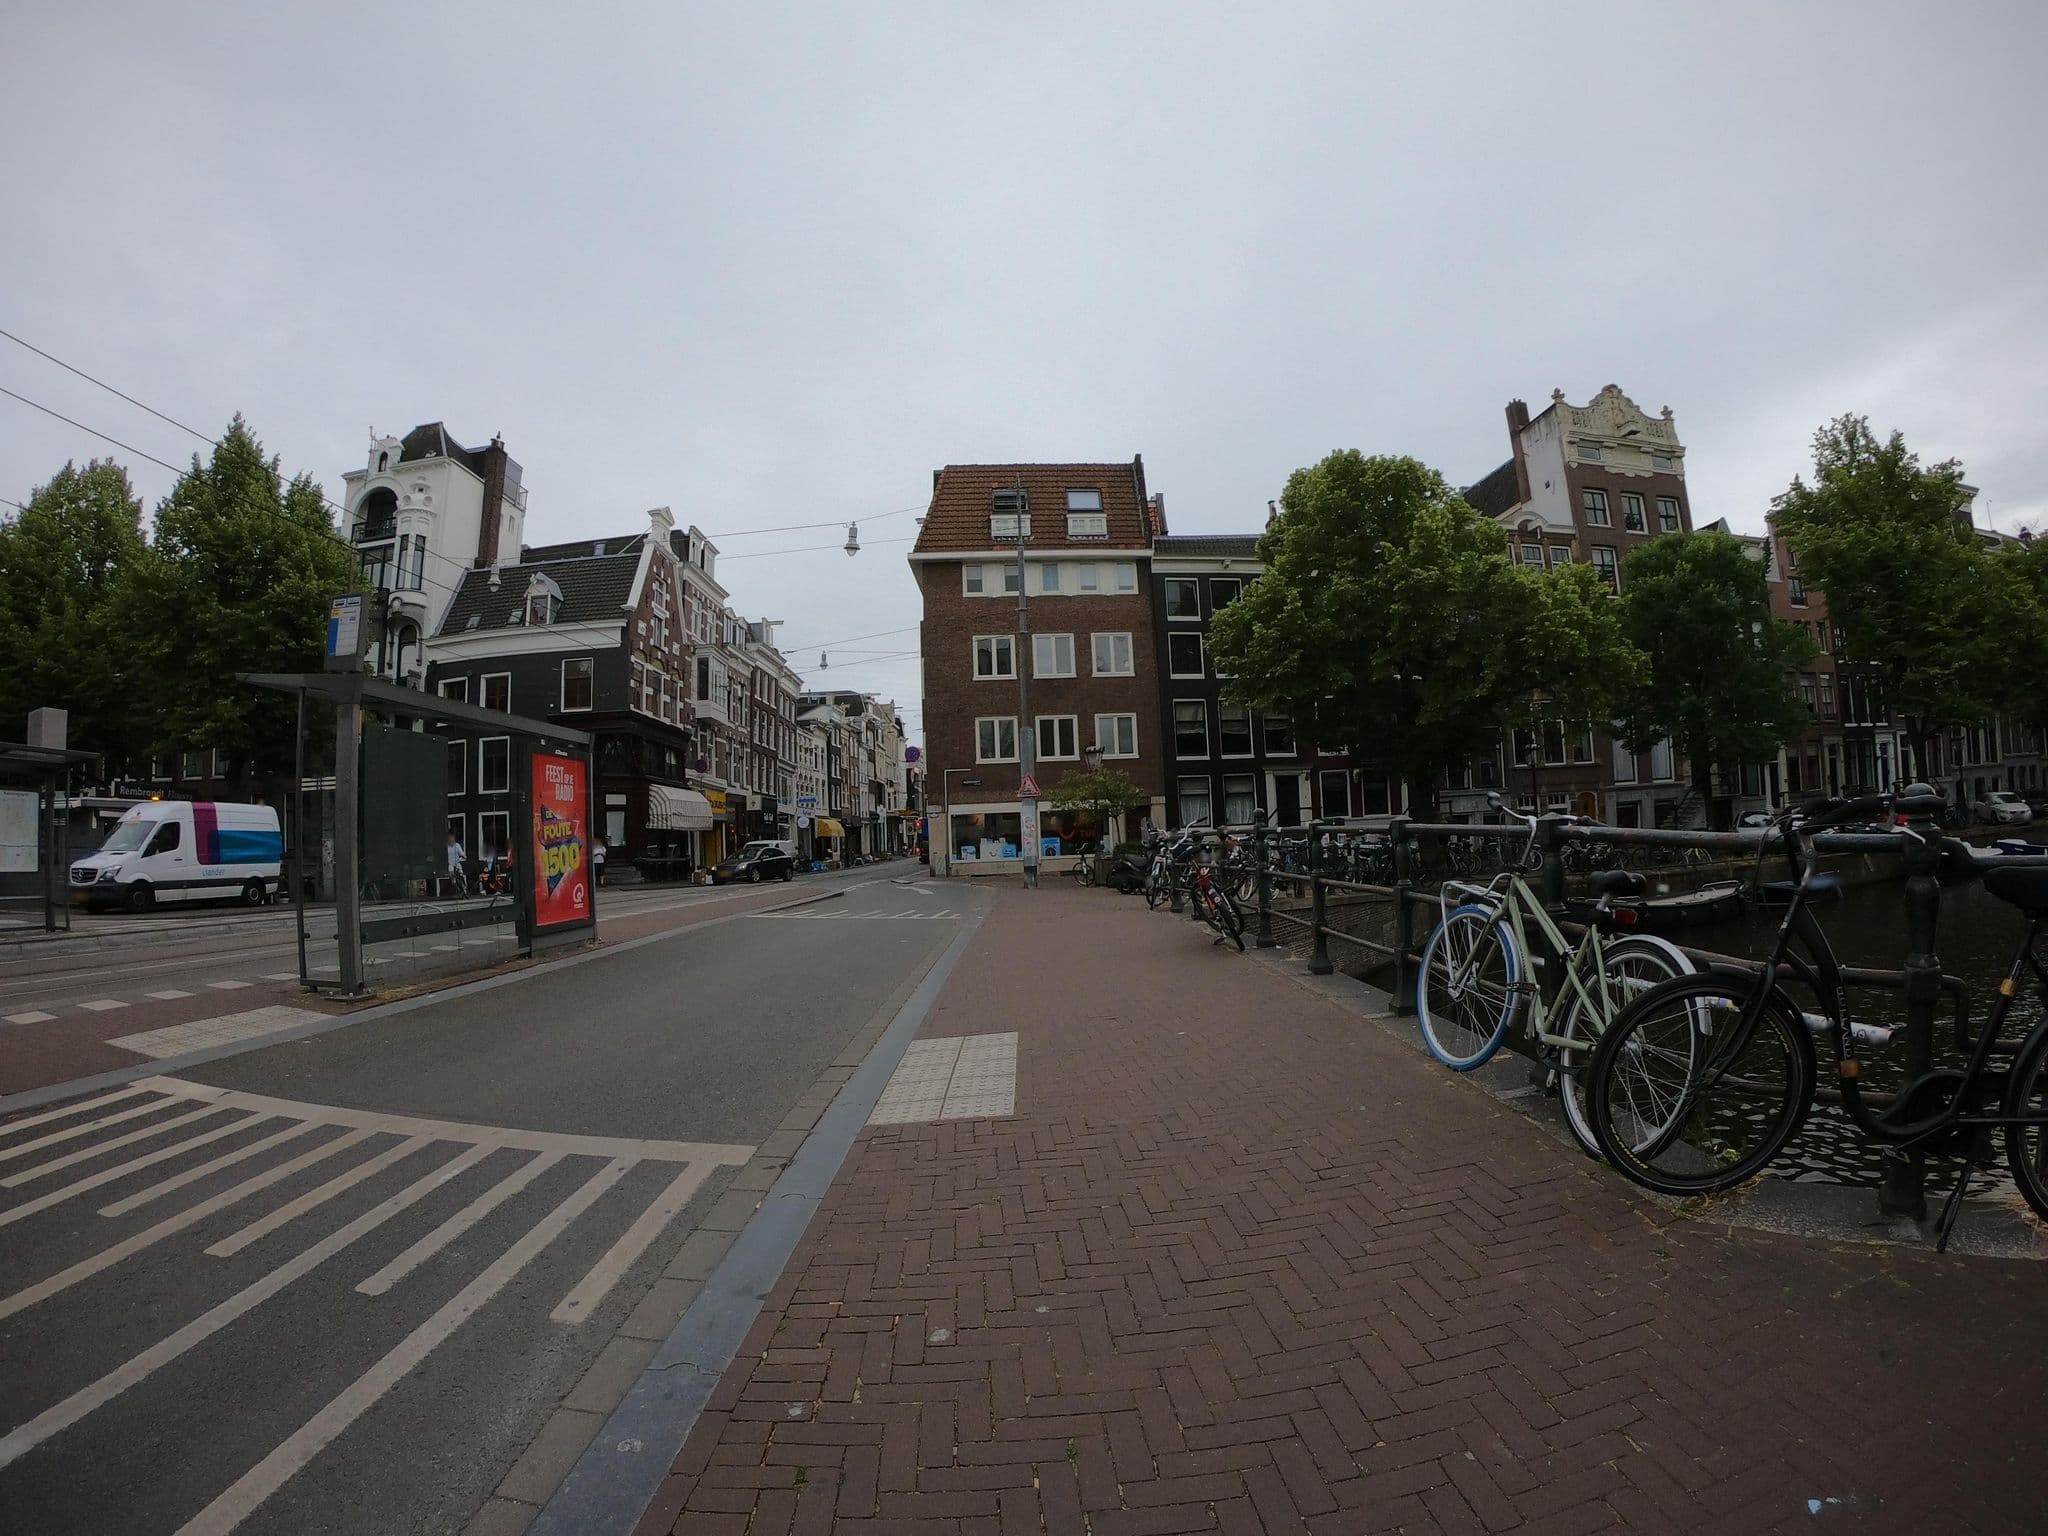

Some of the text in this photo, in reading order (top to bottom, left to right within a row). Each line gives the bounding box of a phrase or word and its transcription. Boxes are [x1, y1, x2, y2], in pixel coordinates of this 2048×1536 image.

[545, 764, 563, 783] FEEST
[555, 783, 574, 801] RADIO
[543, 822, 572, 841] FOUTE
[542, 844, 580, 877] 1500
